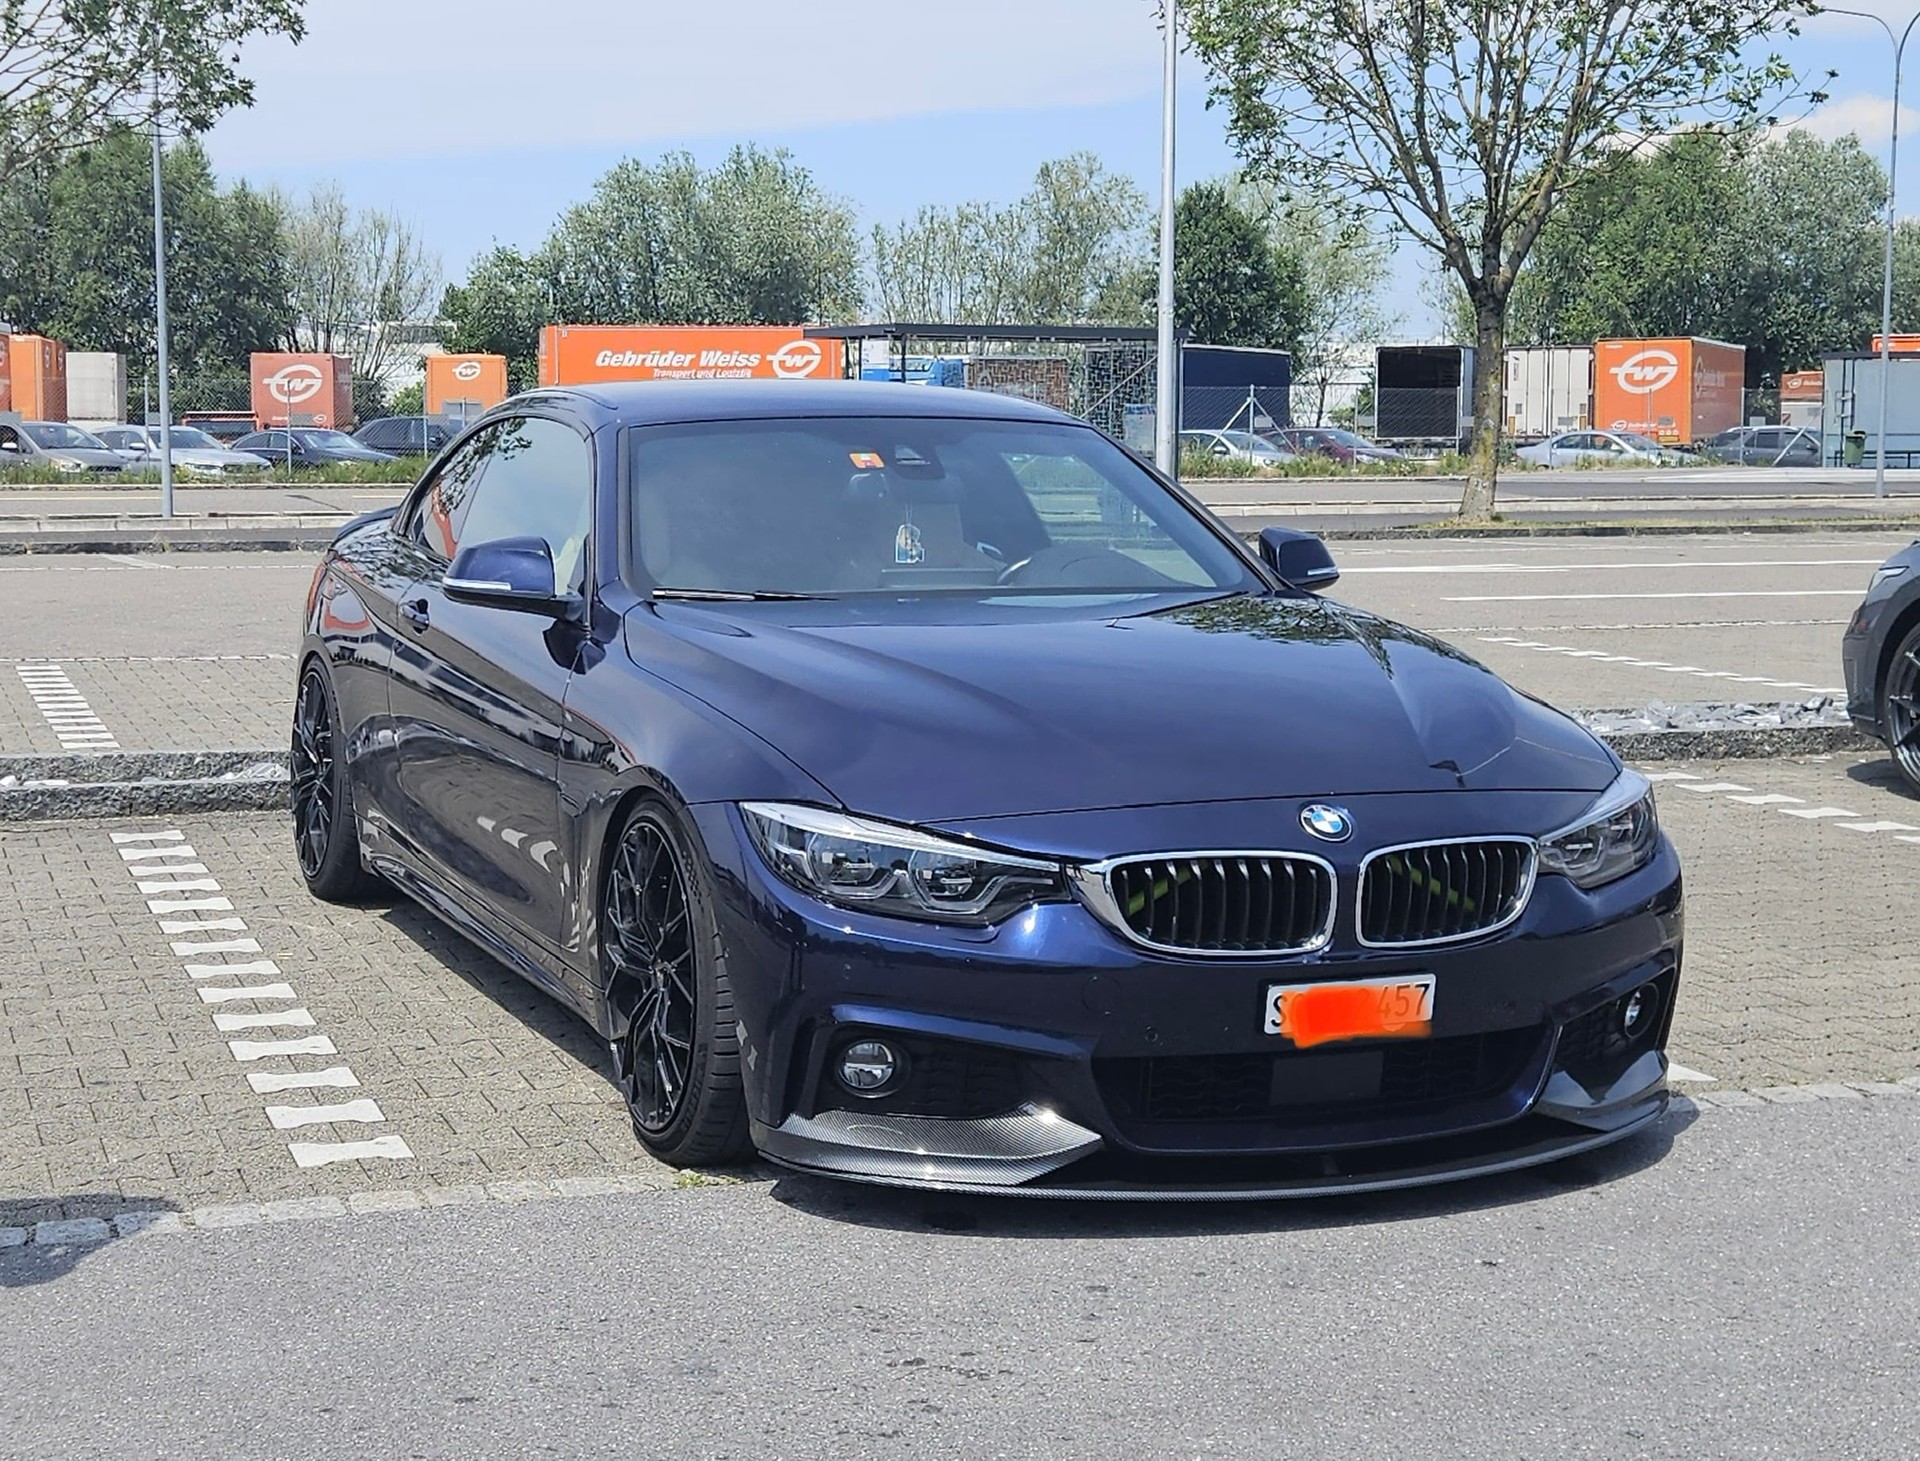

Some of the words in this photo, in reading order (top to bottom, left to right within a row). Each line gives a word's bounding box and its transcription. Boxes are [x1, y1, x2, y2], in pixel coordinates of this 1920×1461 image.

[595, 350, 695, 368] Gebrüder
[700, 350, 760, 367] Weiss
[653, 369, 695, 379] Transport
[697, 369, 715, 379] und
